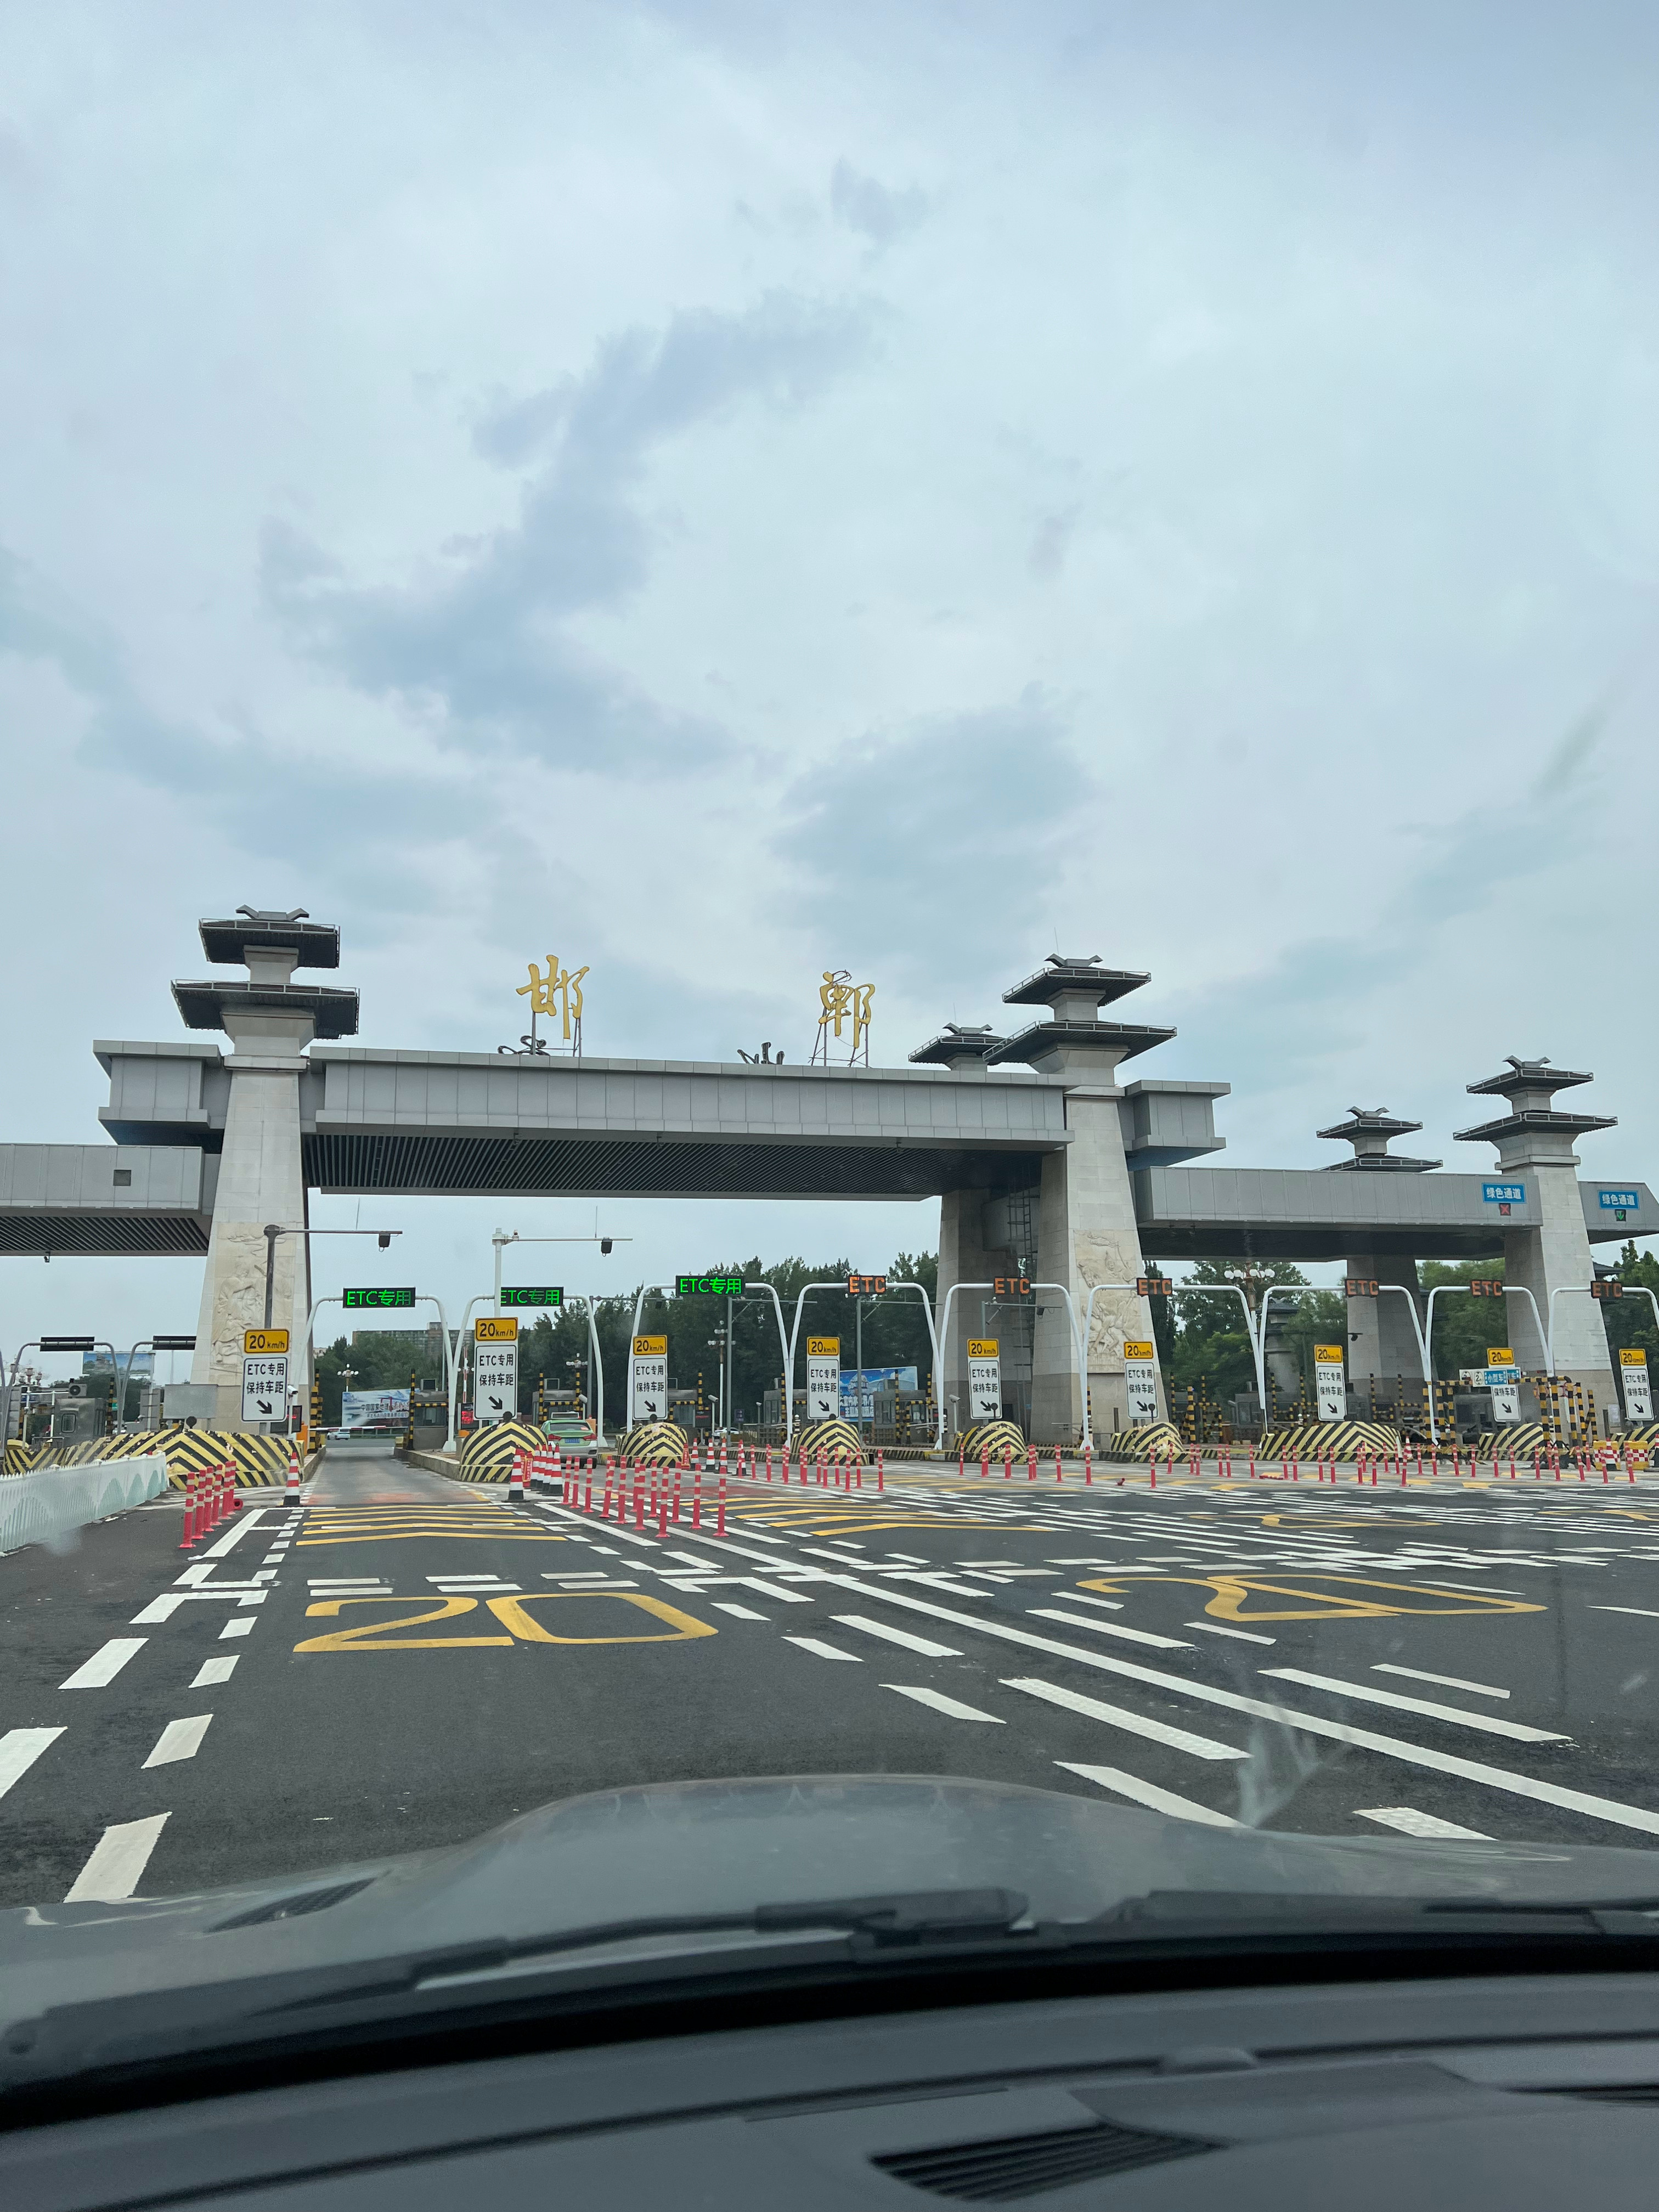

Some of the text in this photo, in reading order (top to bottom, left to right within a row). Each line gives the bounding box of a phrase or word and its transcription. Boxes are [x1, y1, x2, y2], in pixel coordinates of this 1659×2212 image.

[1486, 1187, 1521, 1199] 绿色通道
[1601, 1193, 1635, 1206] 绿色通道
[680, 1277, 741, 1294] ETC专用
[849, 1276, 885, 1293] ETC
[995, 1278, 1030, 1294] ETC
[1138, 1279, 1172, 1295] ETC
[1347, 1280, 1379, 1296] ETC
[1471, 1280, 1502, 1296] ETC
[1593, 1282, 1622, 1297] ETC
[346, 1289, 411, 1306] ETC专用
[500, 1289, 560, 1305] ETC专用
[479, 1354, 514, 1366] ETC专用
[247, 1363, 284, 1375] ETC专用
[636, 1365, 664, 1375] ETC专用
[810, 1369, 837, 1379] ETC专用
[972, 1368, 997, 1378] ETC专用
[1128, 1369, 1153, 1379] ETC专用
[479, 1373, 514, 1386] 保持车距
[1318, 1372, 1342, 1381] ETC专用
[247, 1380, 284, 1394] 保持车距
[636, 1381, 664, 1392] 保持车距
[811, 1383, 837, 1393] 保持车距
[973, 1383, 998, 1393] 保持车距
[1128, 1383, 1154, 1394] 保持车距
[1075, 1574, 1548, 1622] 20
[293, 1592, 719, 1652] 20
